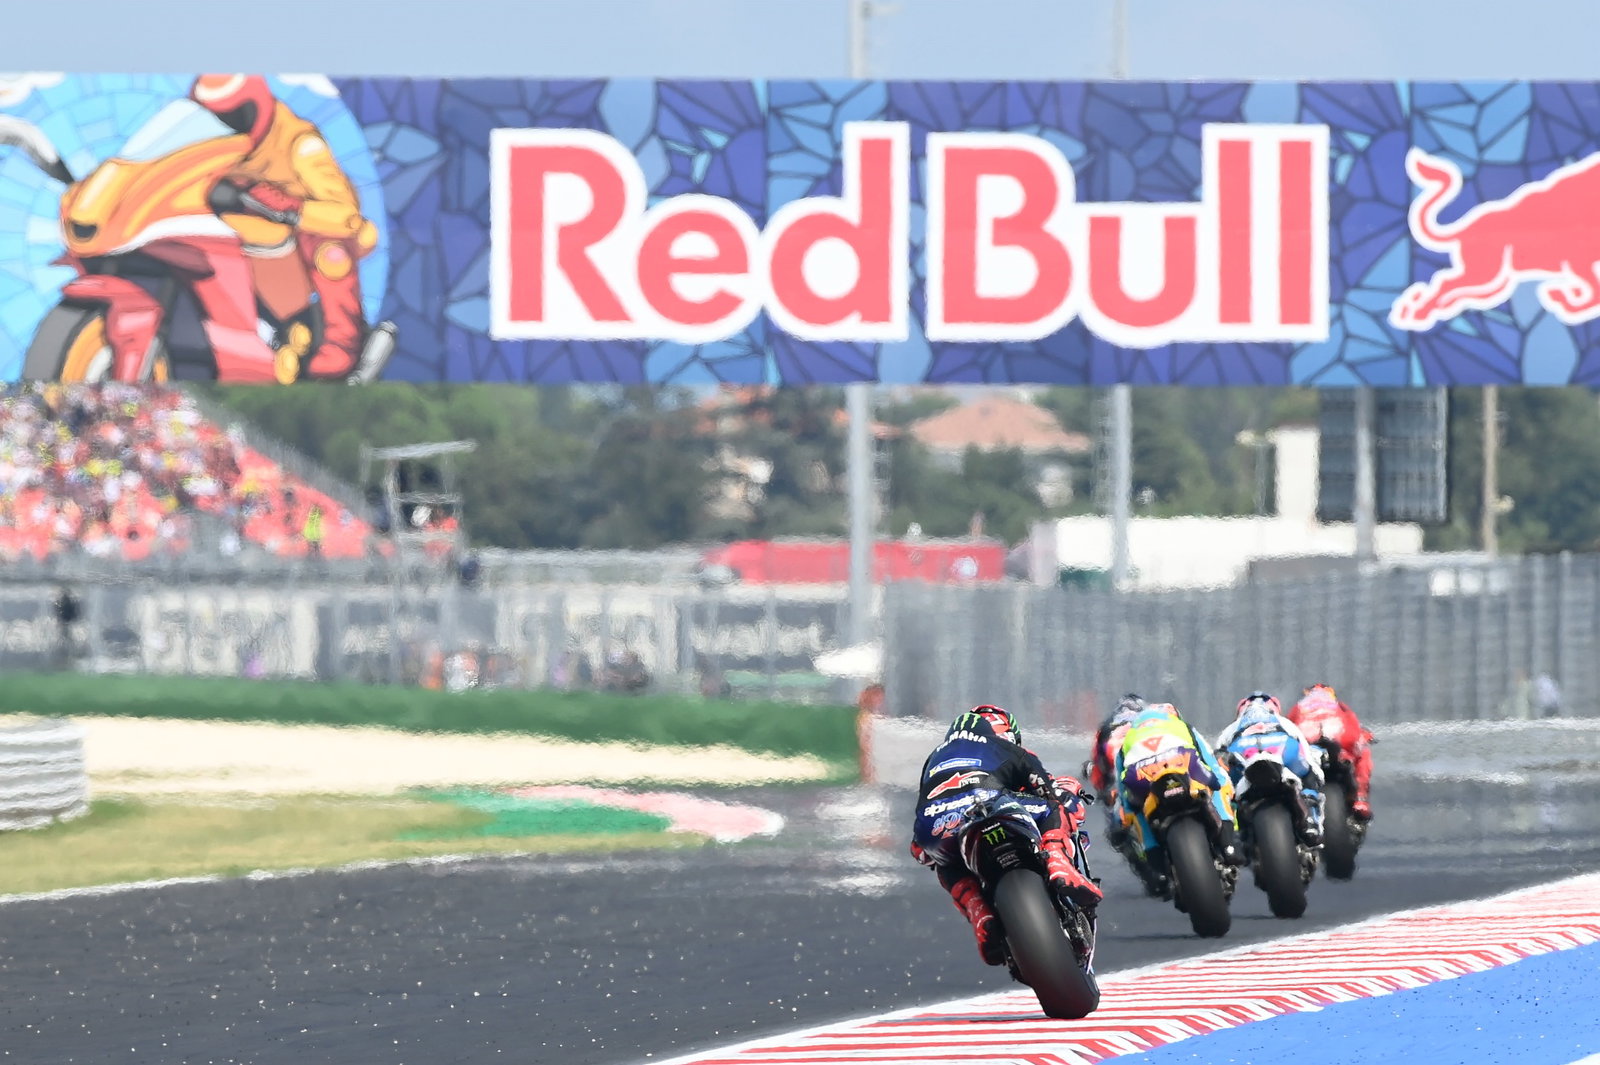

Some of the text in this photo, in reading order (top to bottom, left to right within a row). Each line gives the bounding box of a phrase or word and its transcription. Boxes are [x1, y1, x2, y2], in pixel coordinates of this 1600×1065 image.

[506, 135, 1315, 330] Red Bull
[936, 730, 988, 752] MAHA
